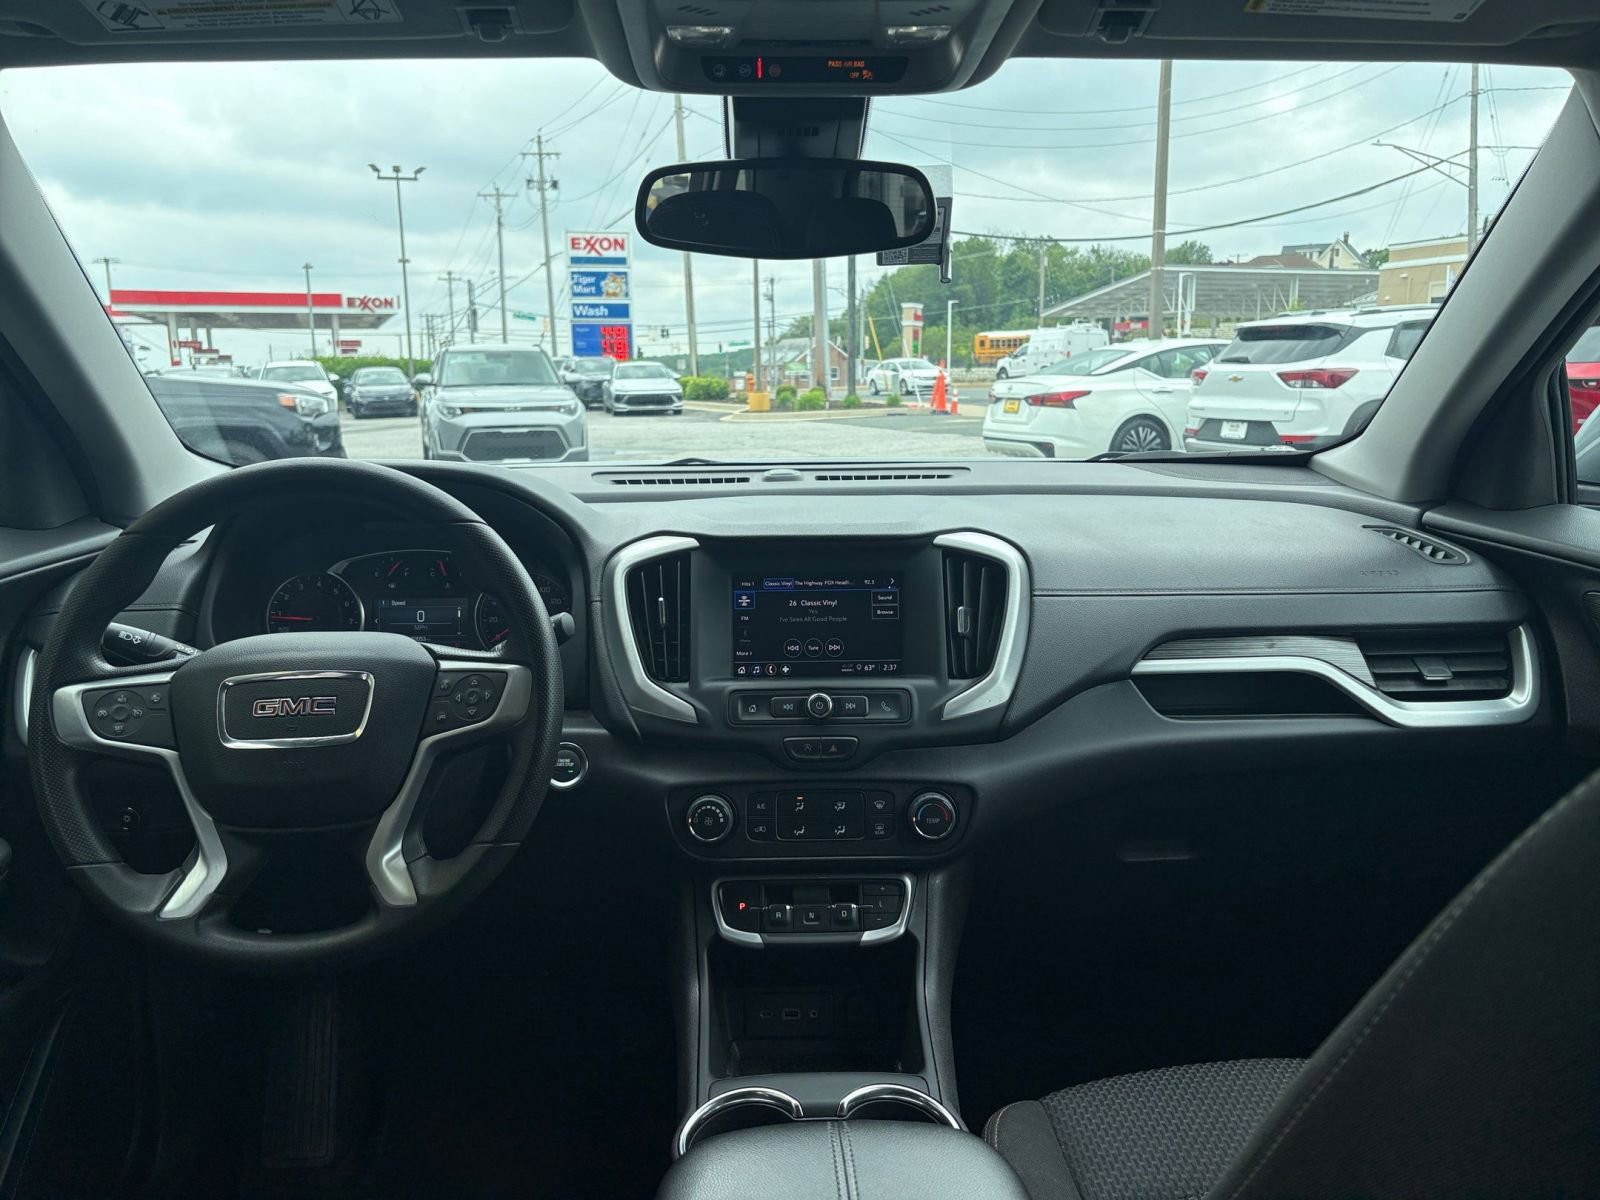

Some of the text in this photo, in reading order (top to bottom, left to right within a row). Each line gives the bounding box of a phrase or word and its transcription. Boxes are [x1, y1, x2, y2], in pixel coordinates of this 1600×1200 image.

[828, 60, 842, 68] PASS
[853, 60, 865, 68] BAG
[849, 71, 859, 79] OFF
[571, 236, 625, 257] EXXON
[572, 275, 596, 286] Tiger
[573, 286, 596, 294] Mart
[346, 296, 394, 313] EXXON
[573, 305, 609, 317] Wash
[781, 580, 793, 588] Vinyl
[803, 580, 823, 588] Highway
[788, 599, 838, 608] 26 Classic Vinyl
[416, 610, 425, 623] 0
[828, 615, 848, 623] People
[252, 696, 336, 717] GMC
[739, 902, 746, 910] P
[775, 911, 782, 919] R
[808, 911, 816, 919] N
[841, 910, 848, 918] D
